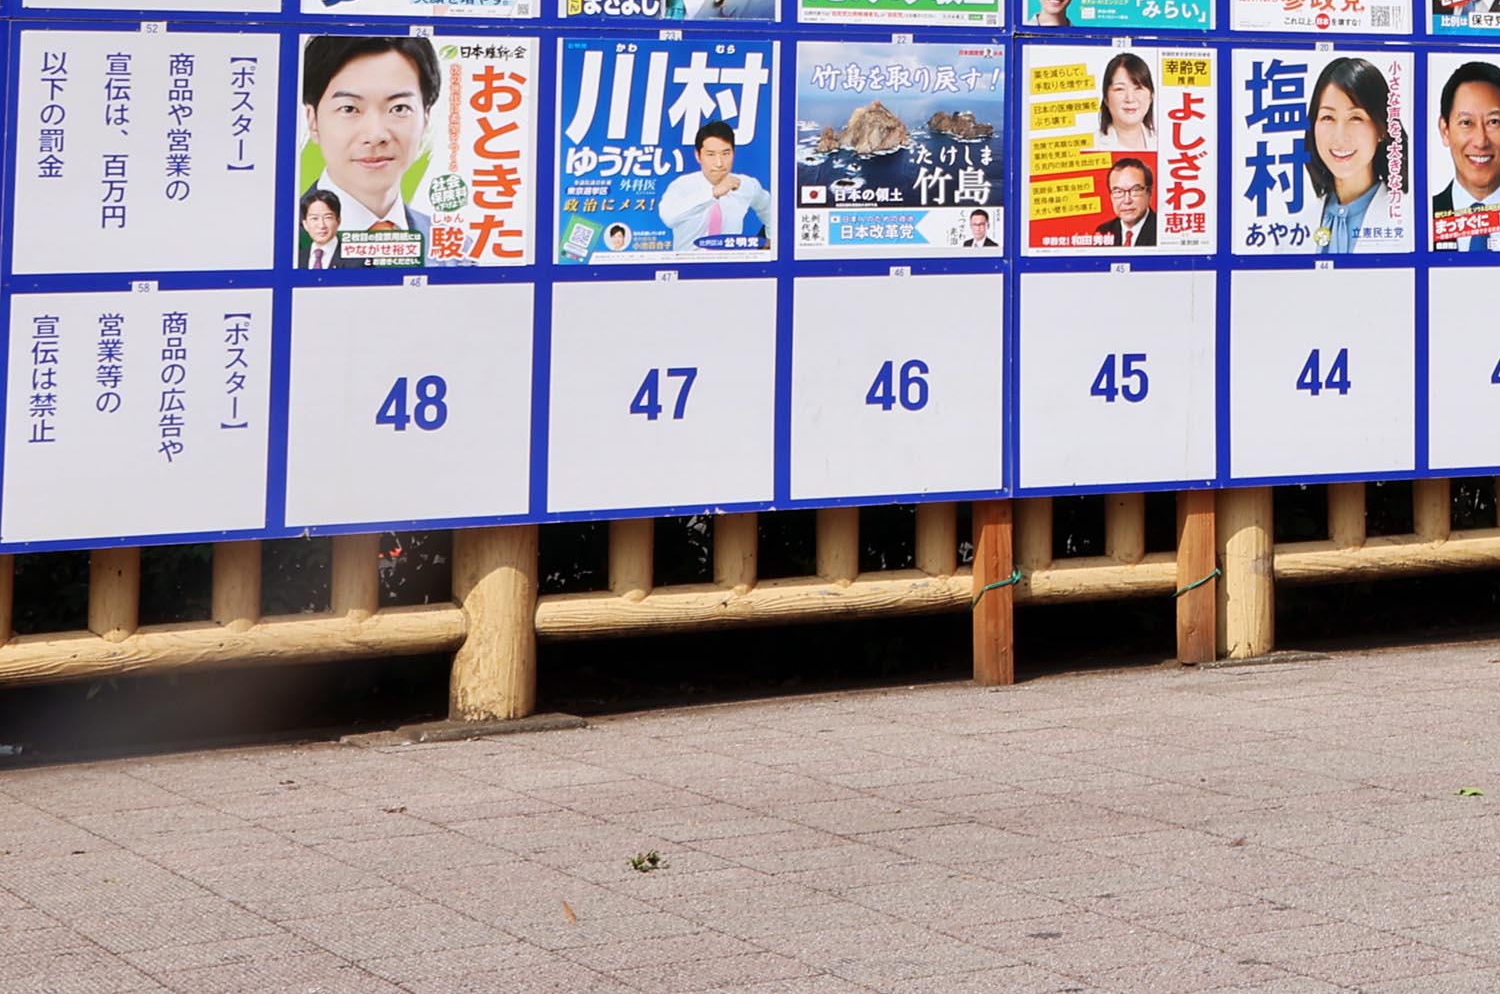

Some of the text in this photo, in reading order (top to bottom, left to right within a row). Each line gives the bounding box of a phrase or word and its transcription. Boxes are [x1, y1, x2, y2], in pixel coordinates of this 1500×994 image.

[616, 43, 736, 54] かわ むら
[1165, 61, 1207, 75] 幸齢党
[565, 51, 769, 145] 川村
[811, 62, 1001, 93] 竹島を取り戻す！
[37, 51, 67, 178] 以下の罰金
[165, 52, 195, 201] 商品や営業の
[227, 54, 258, 172] 【ポスター】
[101, 52, 132, 228] 宣伝は、百万円
[916, 145, 994, 166] たけしま
[1167, 92, 1208, 210] よしざわ
[1244, 59, 1311, 217] 塩村
[1387, 61, 1403, 225] 小さな声を、大きな力に。
[469, 65, 527, 259] おときた
[565, 146, 684, 176] ゆうだい
[563, 198, 656, 212] 政治にメス！
[619, 179, 657, 192] 外科医
[834, 187, 904, 202] 日本の領土
[912, 166, 993, 206] 竹島
[432, 214, 464, 223] しゅん
[840, 224, 915, 240] 日本改革党
[1165, 212, 1206, 233] 恵理
[1246, 223, 1310, 247] あやか
[1352, 226, 1404, 239] 立憲民主党
[1436, 217, 1489, 233] まっすぐに
[344, 243, 419, 256] やながせ裕文
[430, 227, 465, 259] 駿
[724, 236, 760, 248] 公明党
[28, 314, 59, 443] 宣伝は禁止
[96, 312, 125, 413] 営業等の
[221, 312, 251, 430] 【ポスター】
[864, 358, 928, 410] 46
[1089, 353, 1148, 402] 45
[1295, 348, 1351, 395] 44
[158, 310, 189, 462] 商品の広告や
[374, 374, 447, 430] 48
[628, 366, 697, 420] 47
